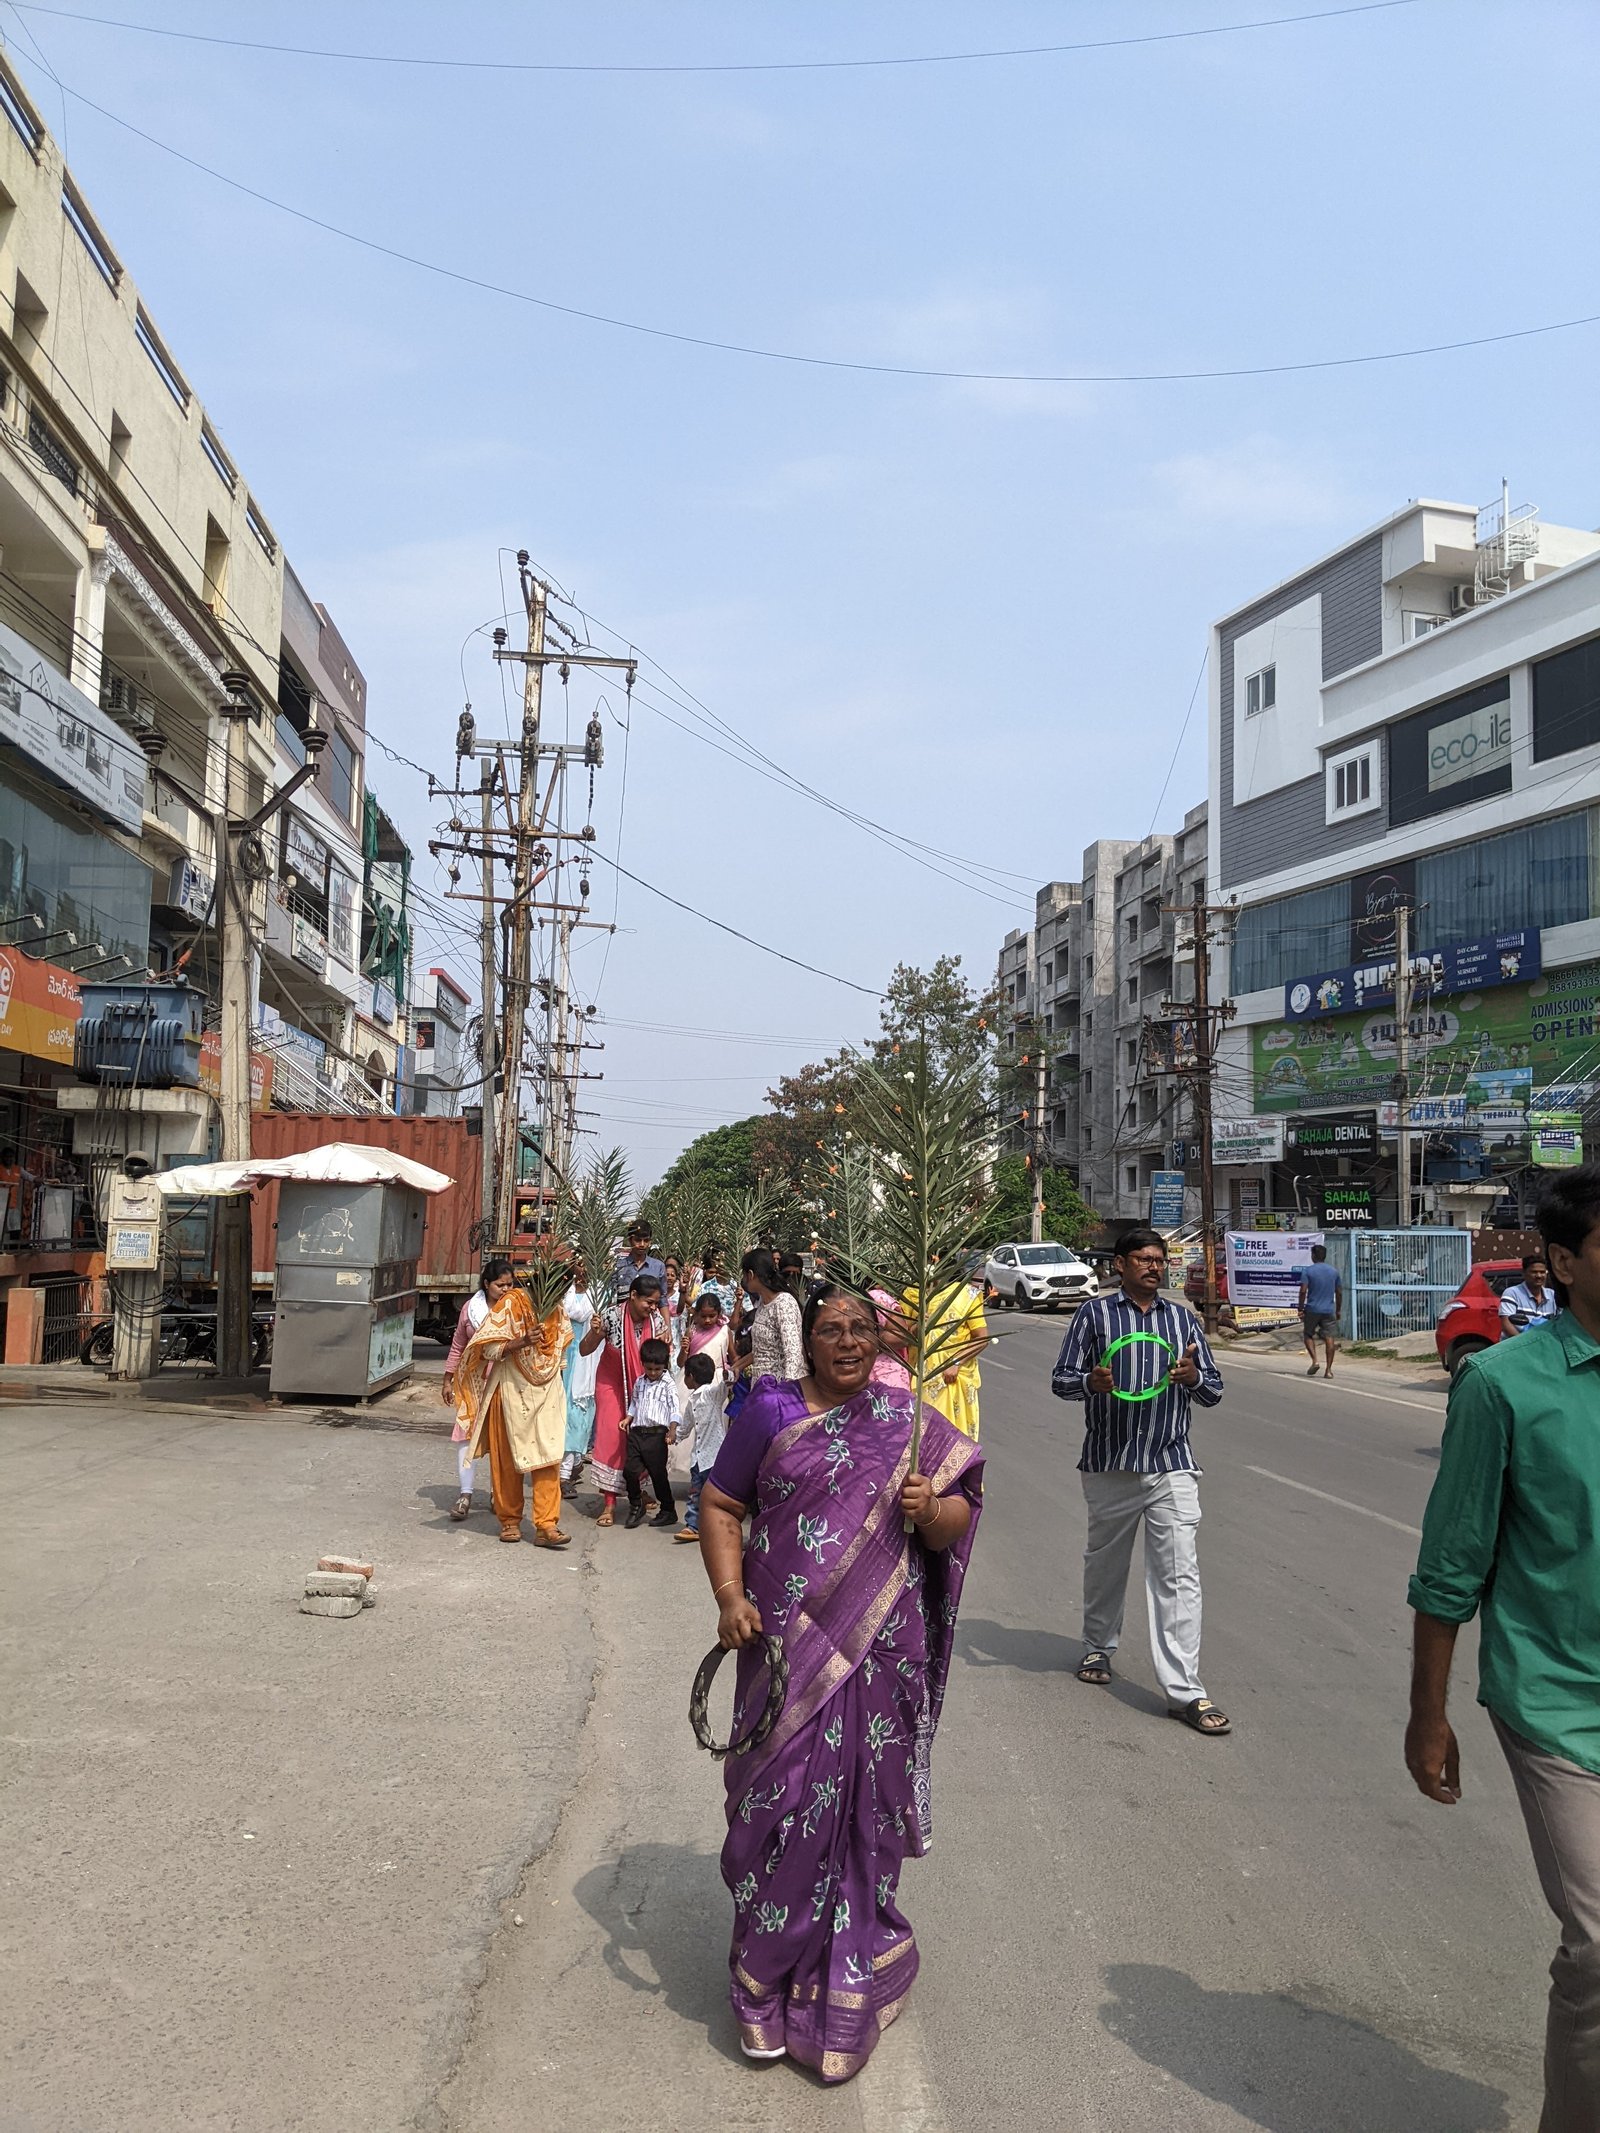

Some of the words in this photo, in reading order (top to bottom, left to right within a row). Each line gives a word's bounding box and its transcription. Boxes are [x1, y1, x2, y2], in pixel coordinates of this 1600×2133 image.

[1531, 996, 1594, 1019] ADMISSIONS
[1532, 1016, 1593, 1042] OPEN
[1298, 1128, 1333, 1144] SAHAJA
[1335, 1125, 1371, 1141] DENTAL
[1310, 1148, 1324, 1156] Sahaja
[1324, 1191, 1370, 1204] SAHAJA
[1326, 1208, 1372, 1221] DENTAL
[1245, 1240, 1268, 1250] FREE
[1242, 1258, 1283, 1266] MANSOORABAD
[1237, 1321, 1261, 1329] TRANSPORT
